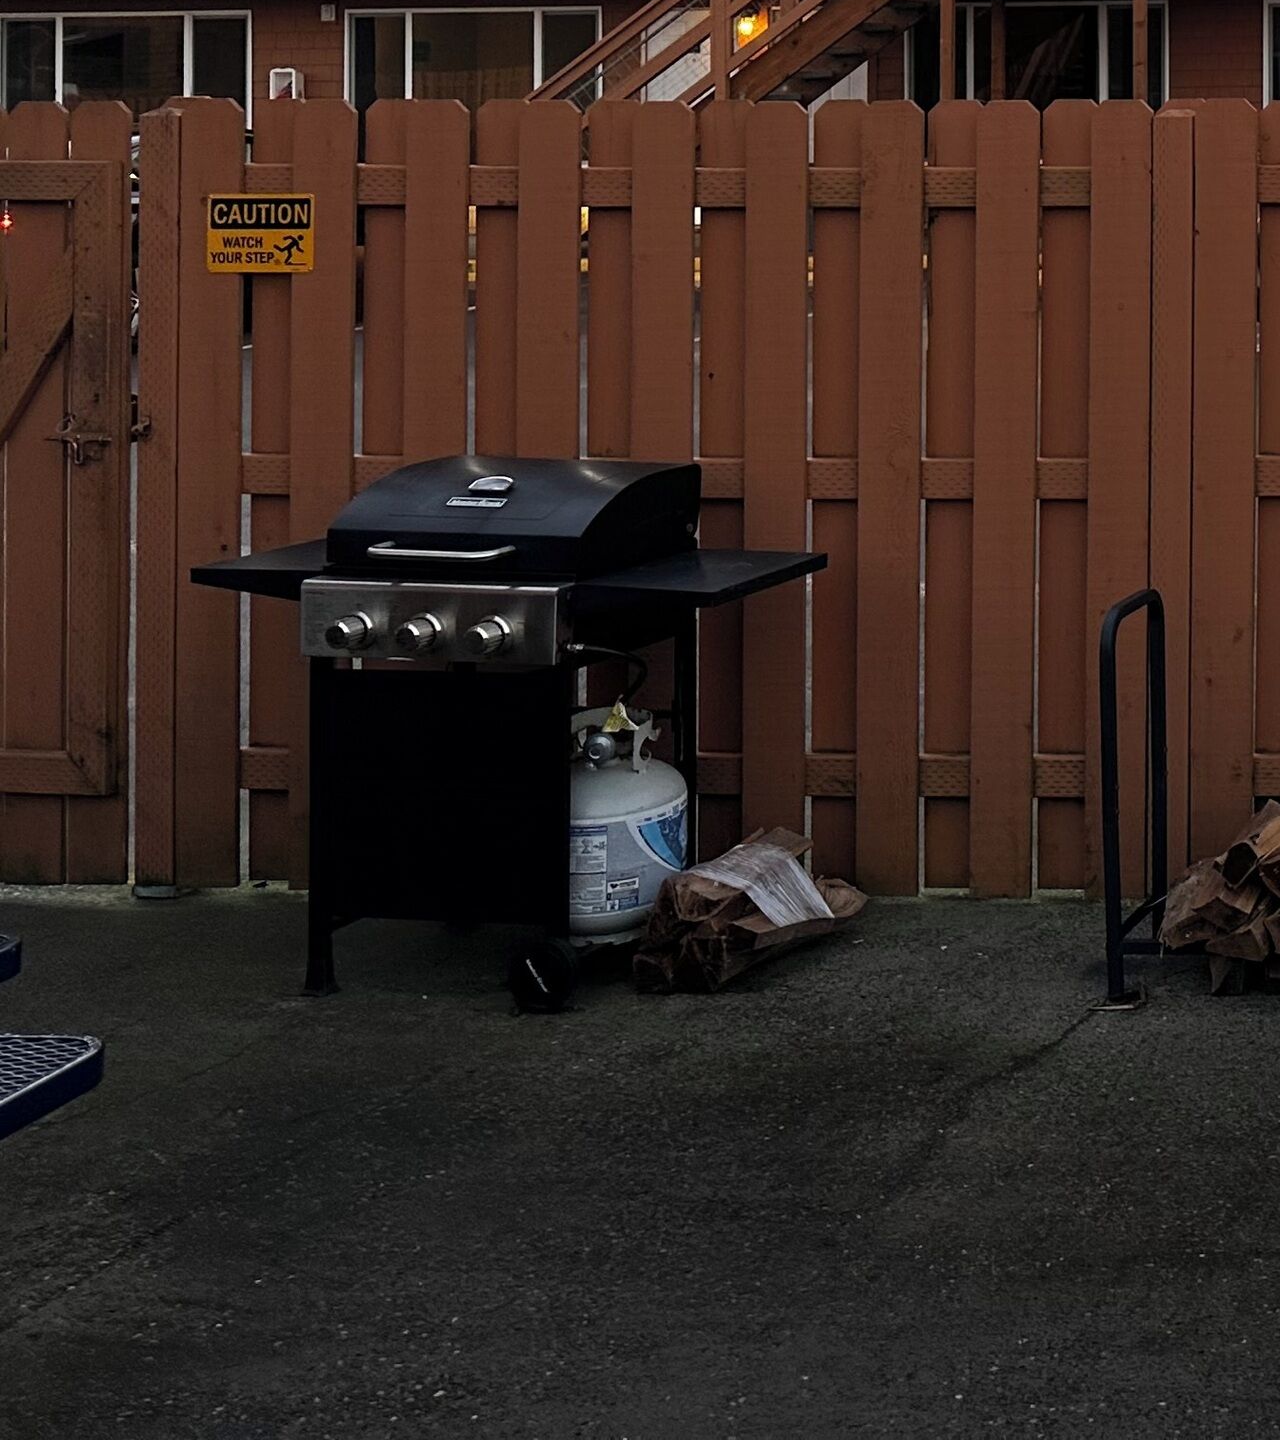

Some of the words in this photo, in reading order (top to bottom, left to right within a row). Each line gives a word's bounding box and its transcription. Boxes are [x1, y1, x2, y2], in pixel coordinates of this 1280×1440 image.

[213, 203, 308, 225] CAUTION
[222, 236, 263, 249] WATCH
[210, 252, 242, 264] YOUR
[245, 251, 275, 264] STEP
